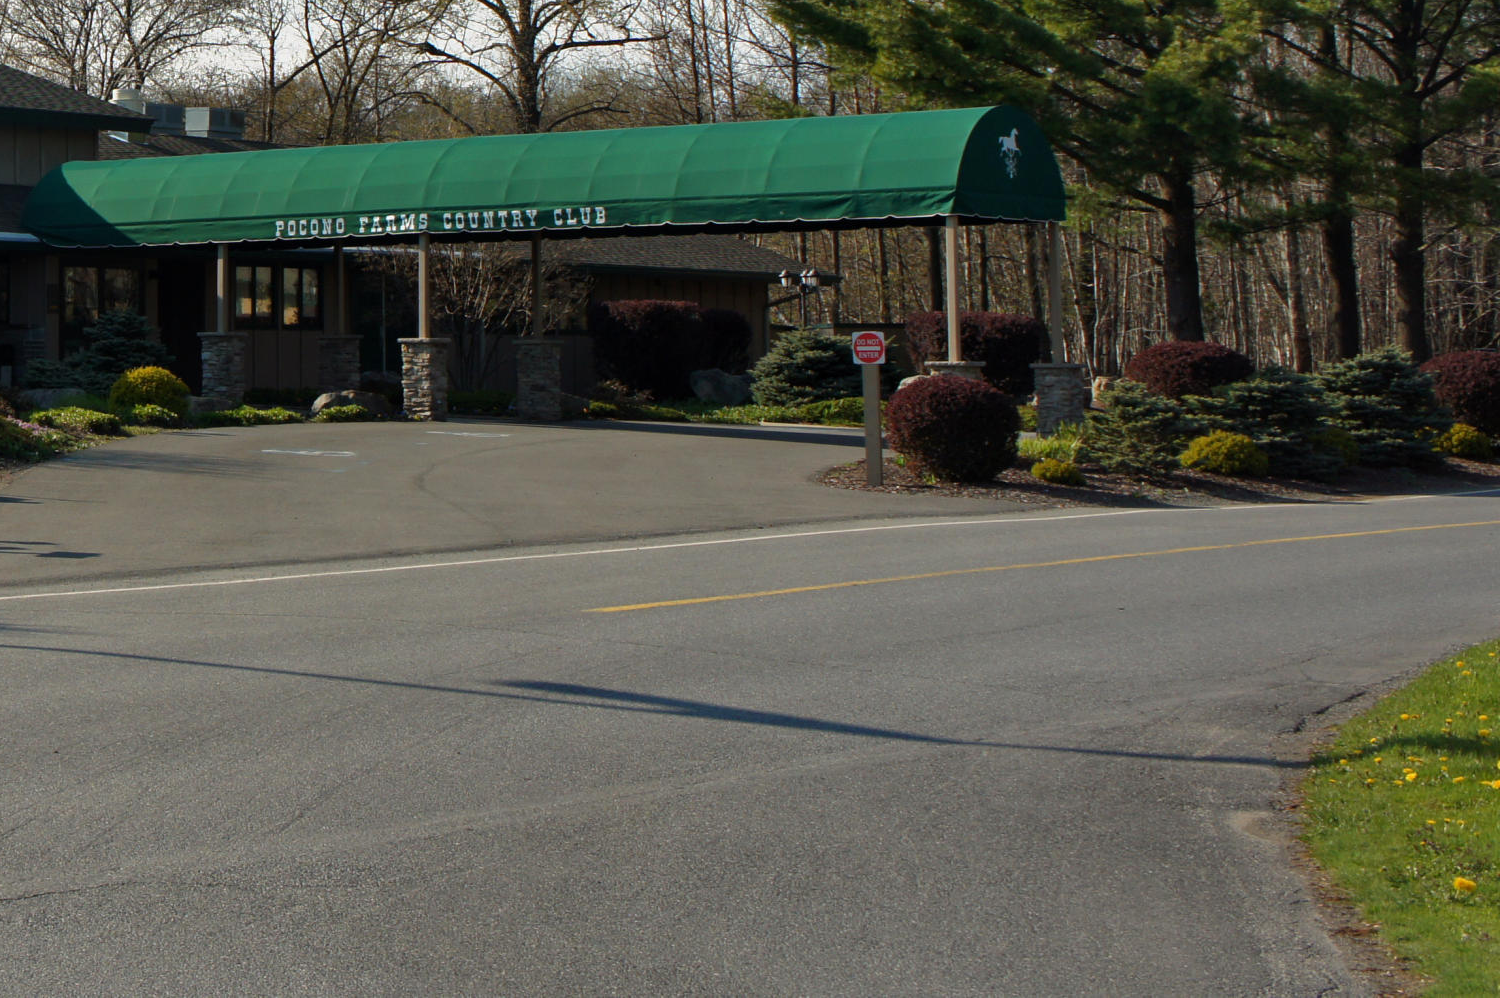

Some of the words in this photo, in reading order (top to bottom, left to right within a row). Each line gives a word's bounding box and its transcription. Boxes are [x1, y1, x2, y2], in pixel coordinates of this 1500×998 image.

[275, 217, 345, 237] POCONO
[359, 213, 429, 233] FARMS
[443, 209, 539, 230] COUNTRY
[553, 206, 606, 226] CLUB
